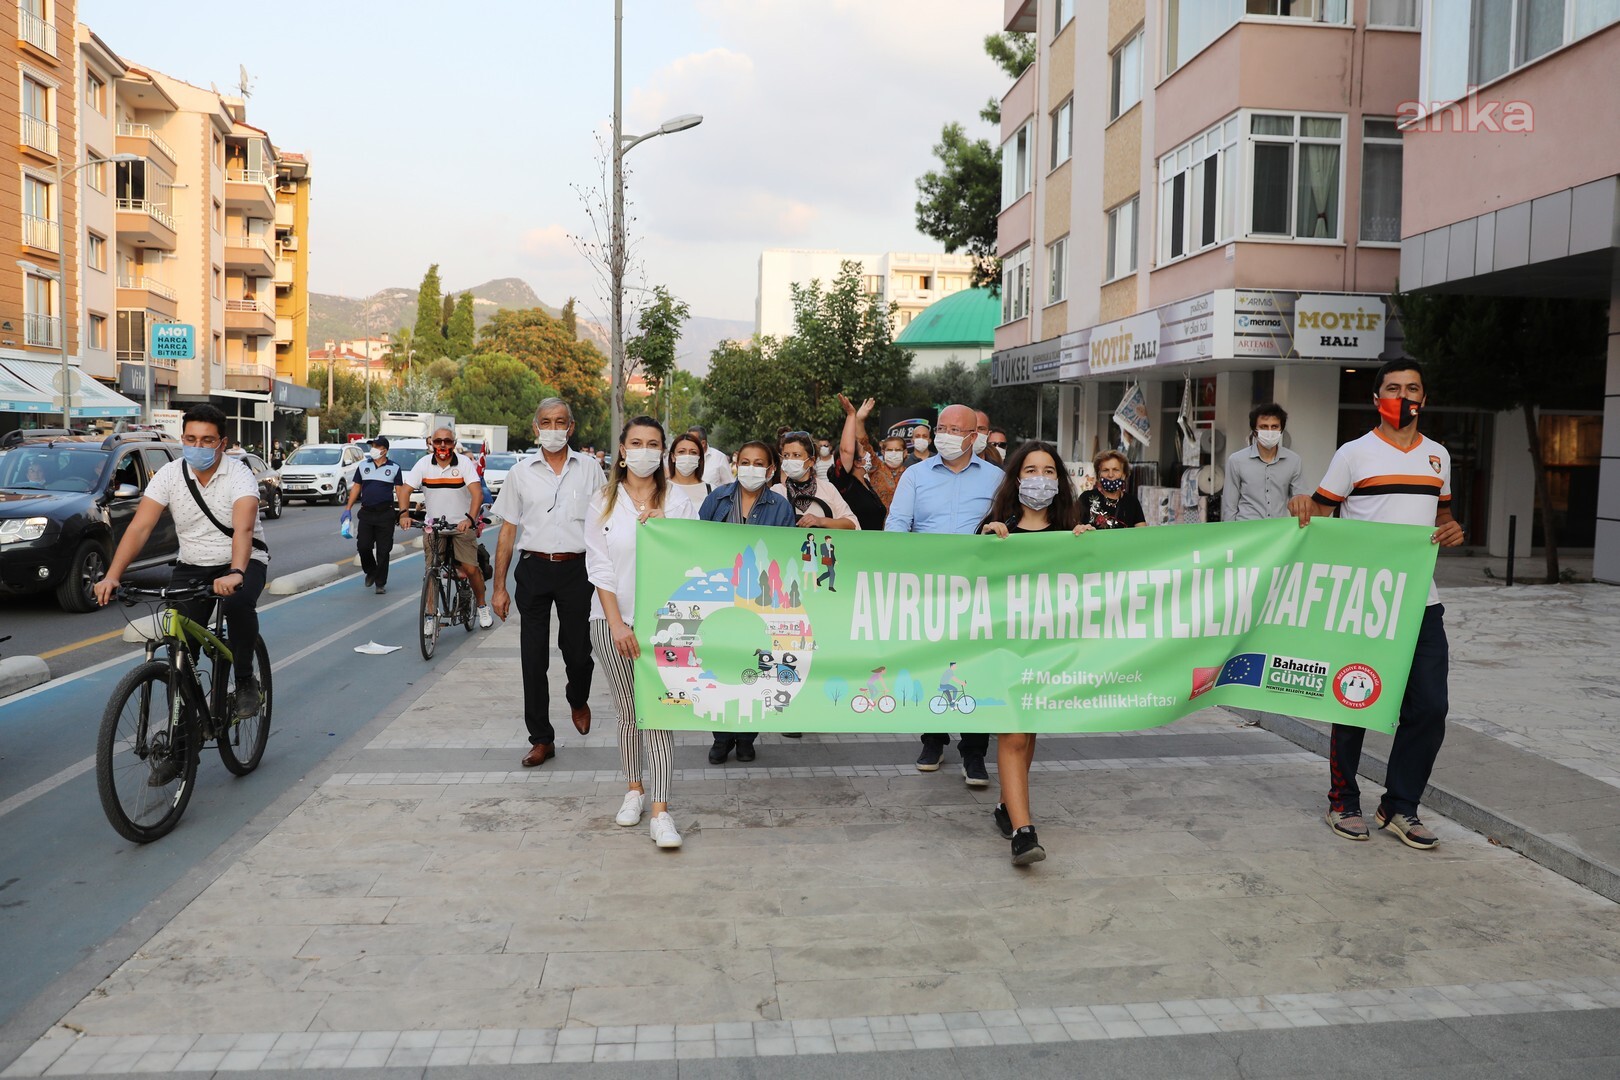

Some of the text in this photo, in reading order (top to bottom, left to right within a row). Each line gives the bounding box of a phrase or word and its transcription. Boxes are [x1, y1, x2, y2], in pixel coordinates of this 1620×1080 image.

[1250, 318, 1281, 328] merinos
[1298, 307, 1382, 331] MOTİF
[1090, 324, 1133, 369] MOTİF
[1134, 340, 1157, 362] HALI
[1320, 335, 1359, 348] HALI
[1001, 353, 1030, 384] YÜKSEL
[850, 549, 1408, 642] AVRUPA HAREKETLİLİK HAFTASI
[1273, 656, 1327, 675] Bahattin
[1021, 668, 1144, 688] #MobilityWeek
[1270, 670, 1324, 692] GÜMÜŞ
[1021, 692, 1177, 711] #HareketlilikHaftası
